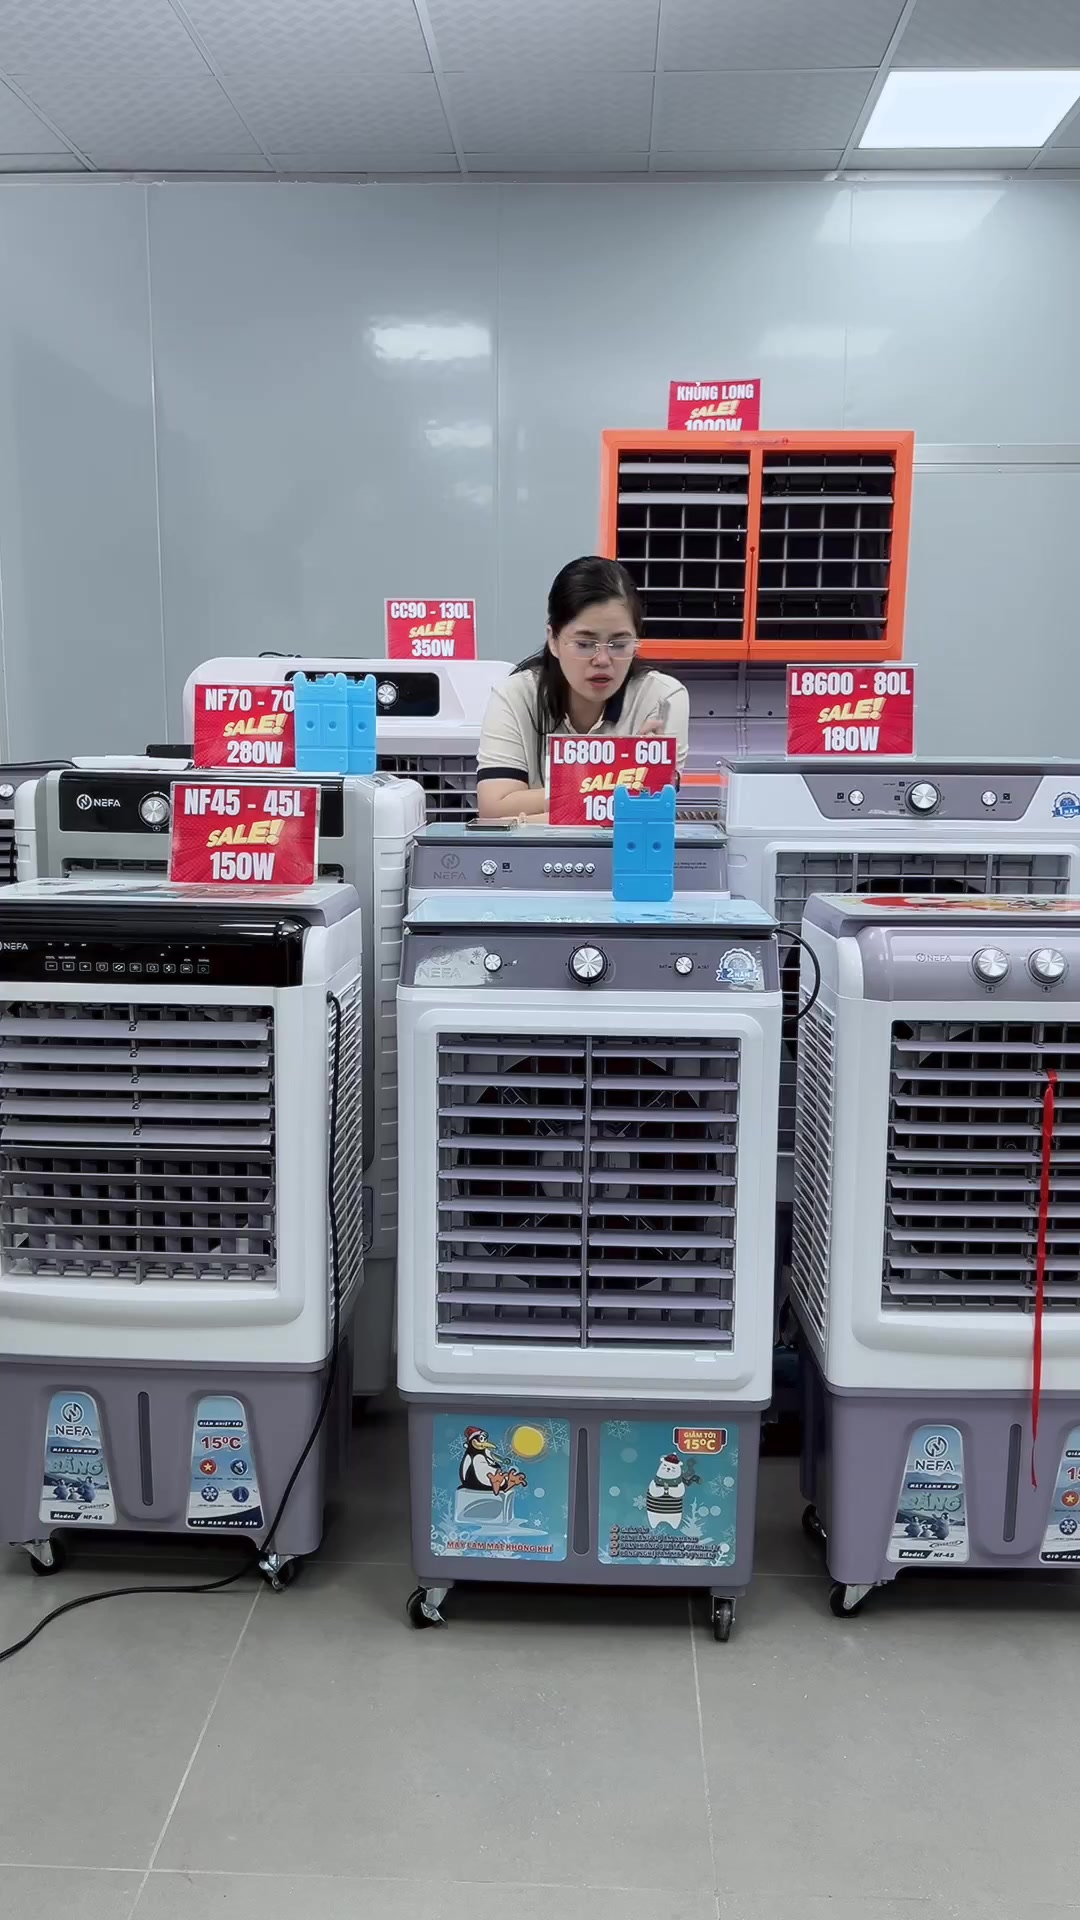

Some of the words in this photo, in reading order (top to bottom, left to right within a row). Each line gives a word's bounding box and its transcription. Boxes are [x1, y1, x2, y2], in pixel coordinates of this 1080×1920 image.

[677, 382, 718, 401] KHỦNG
[722, 384, 754, 400] LONG
[690, 400, 739, 419] SALE!
[685, 418, 742, 431] 1000W
[391, 602, 426, 619] CC90
[439, 602, 471, 619] 130L
[409, 620, 456, 638] SALE!
[412, 639, 455, 657] 350W
[791, 672, 853, 696] L8600
[874, 672, 911, 696] 80L
[205, 688, 252, 711] NF70
[271, 690, 294, 712] 70
[817, 697, 886, 724] SALE!
[223, 713, 288, 737] SALE!
[822, 726, 880, 752] 180W
[227, 740, 283, 764] 280W
[553, 740, 615, 765] L6800
[635, 741, 672, 765] 60L
[579, 767, 648, 793] SALE!
[93, 798, 121, 807] NEFA
[184, 788, 240, 816] NF45
[263, 790, 305, 817] 45L
[583, 795, 615, 821] 160
[206, 819, 285, 848] SALE!
[210, 852, 275, 881] 150W
[433, 871, 467, 881] NEFA
[3, 942, 29, 950] NEFA
[419, 967, 462, 979] NEFA
[727, 968, 734, 978] 2
[55, 1425, 92, 1436] NEFA
[49, 1456, 104, 1476] BĂNG
[915, 1460, 954, 1471] NEFA
[903, 1492, 962, 1512] BĂNG
